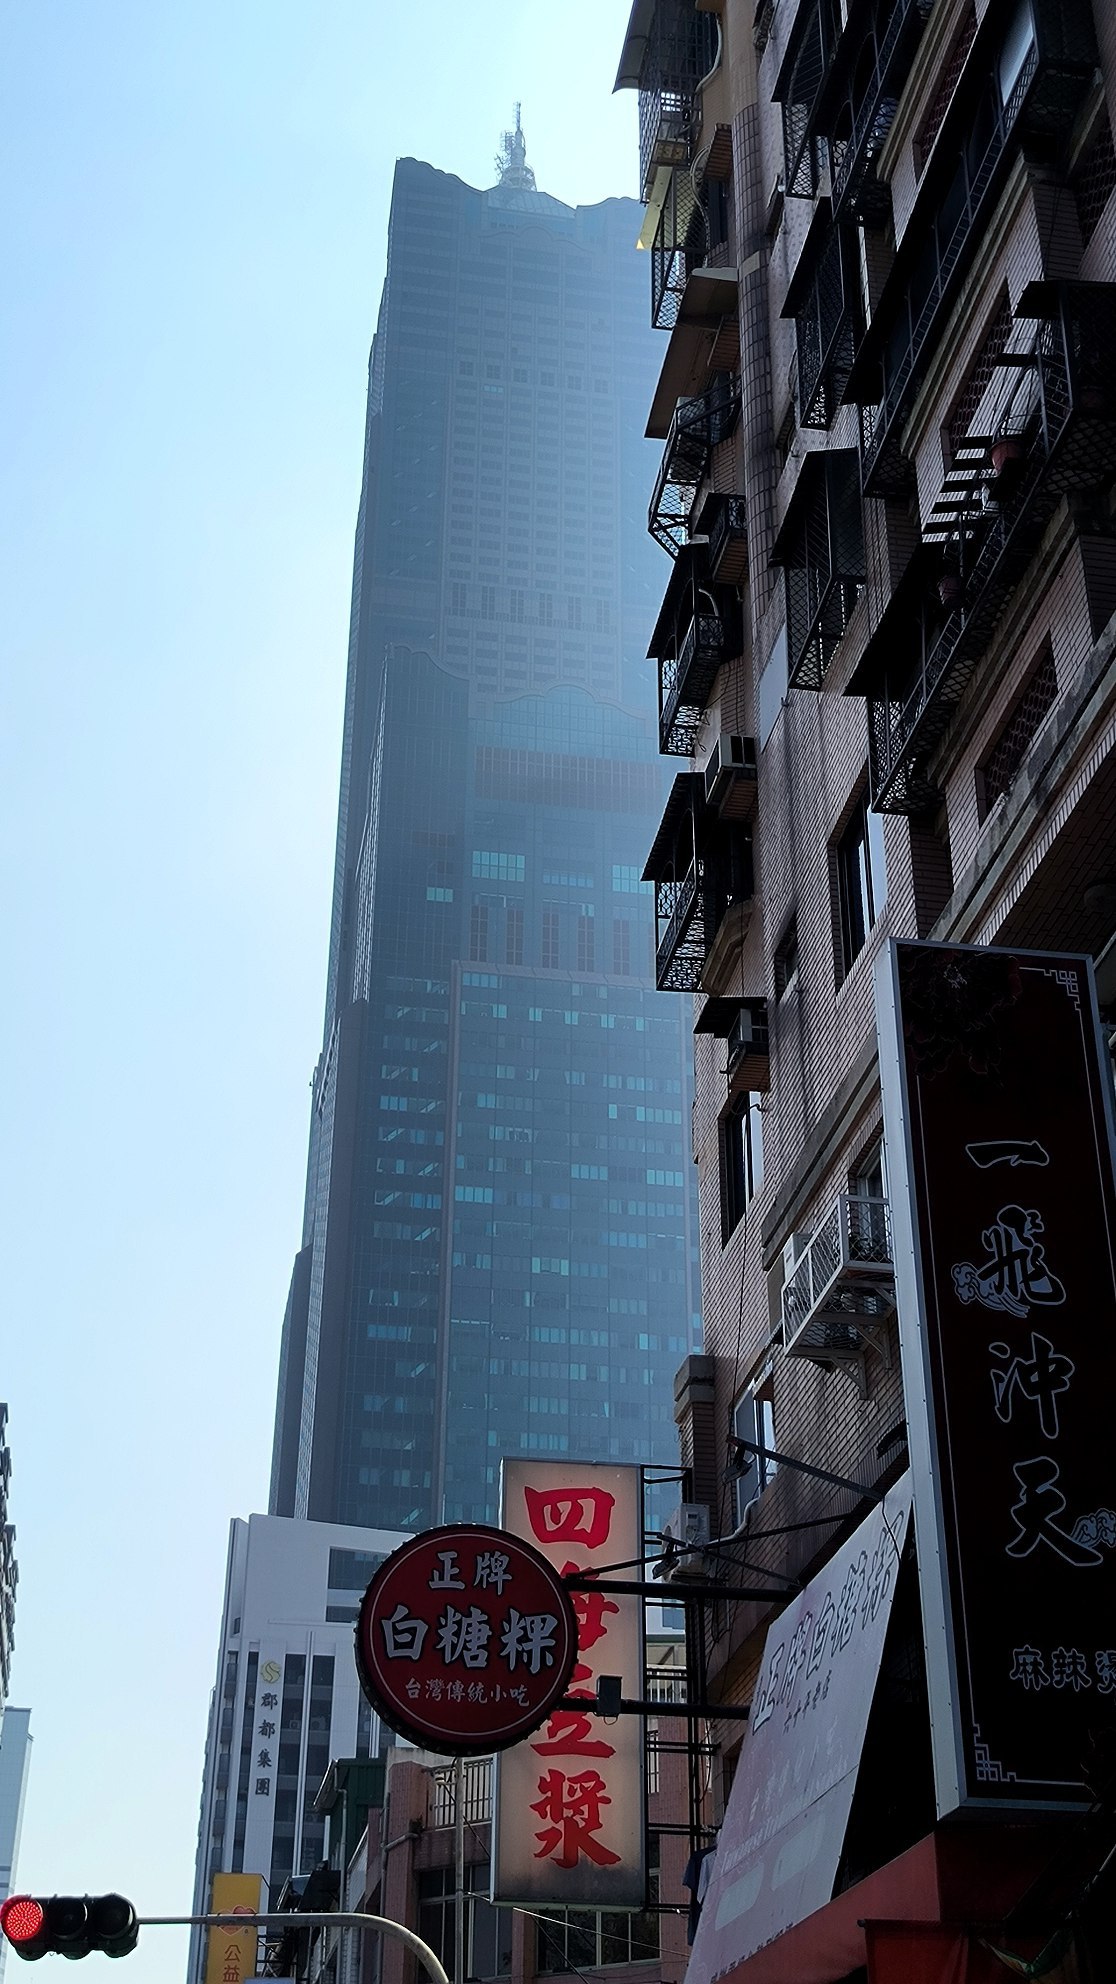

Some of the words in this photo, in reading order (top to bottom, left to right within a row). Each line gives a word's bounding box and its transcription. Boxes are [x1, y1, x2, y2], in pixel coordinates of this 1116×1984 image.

[966, 1141, 1102, 1567] 一飛沖天
[428, 1551, 512, 1595] 正牌
[381, 1604, 558, 1674] 白糖粿
[752, 1510, 904, 1736] 正牌白糖粿
[405, 1678, 530, 1707] 台灣傳統小吃
[255, 1692, 278, 1796] 郡都集團
[223, 1944, 241, 1982] 公益
